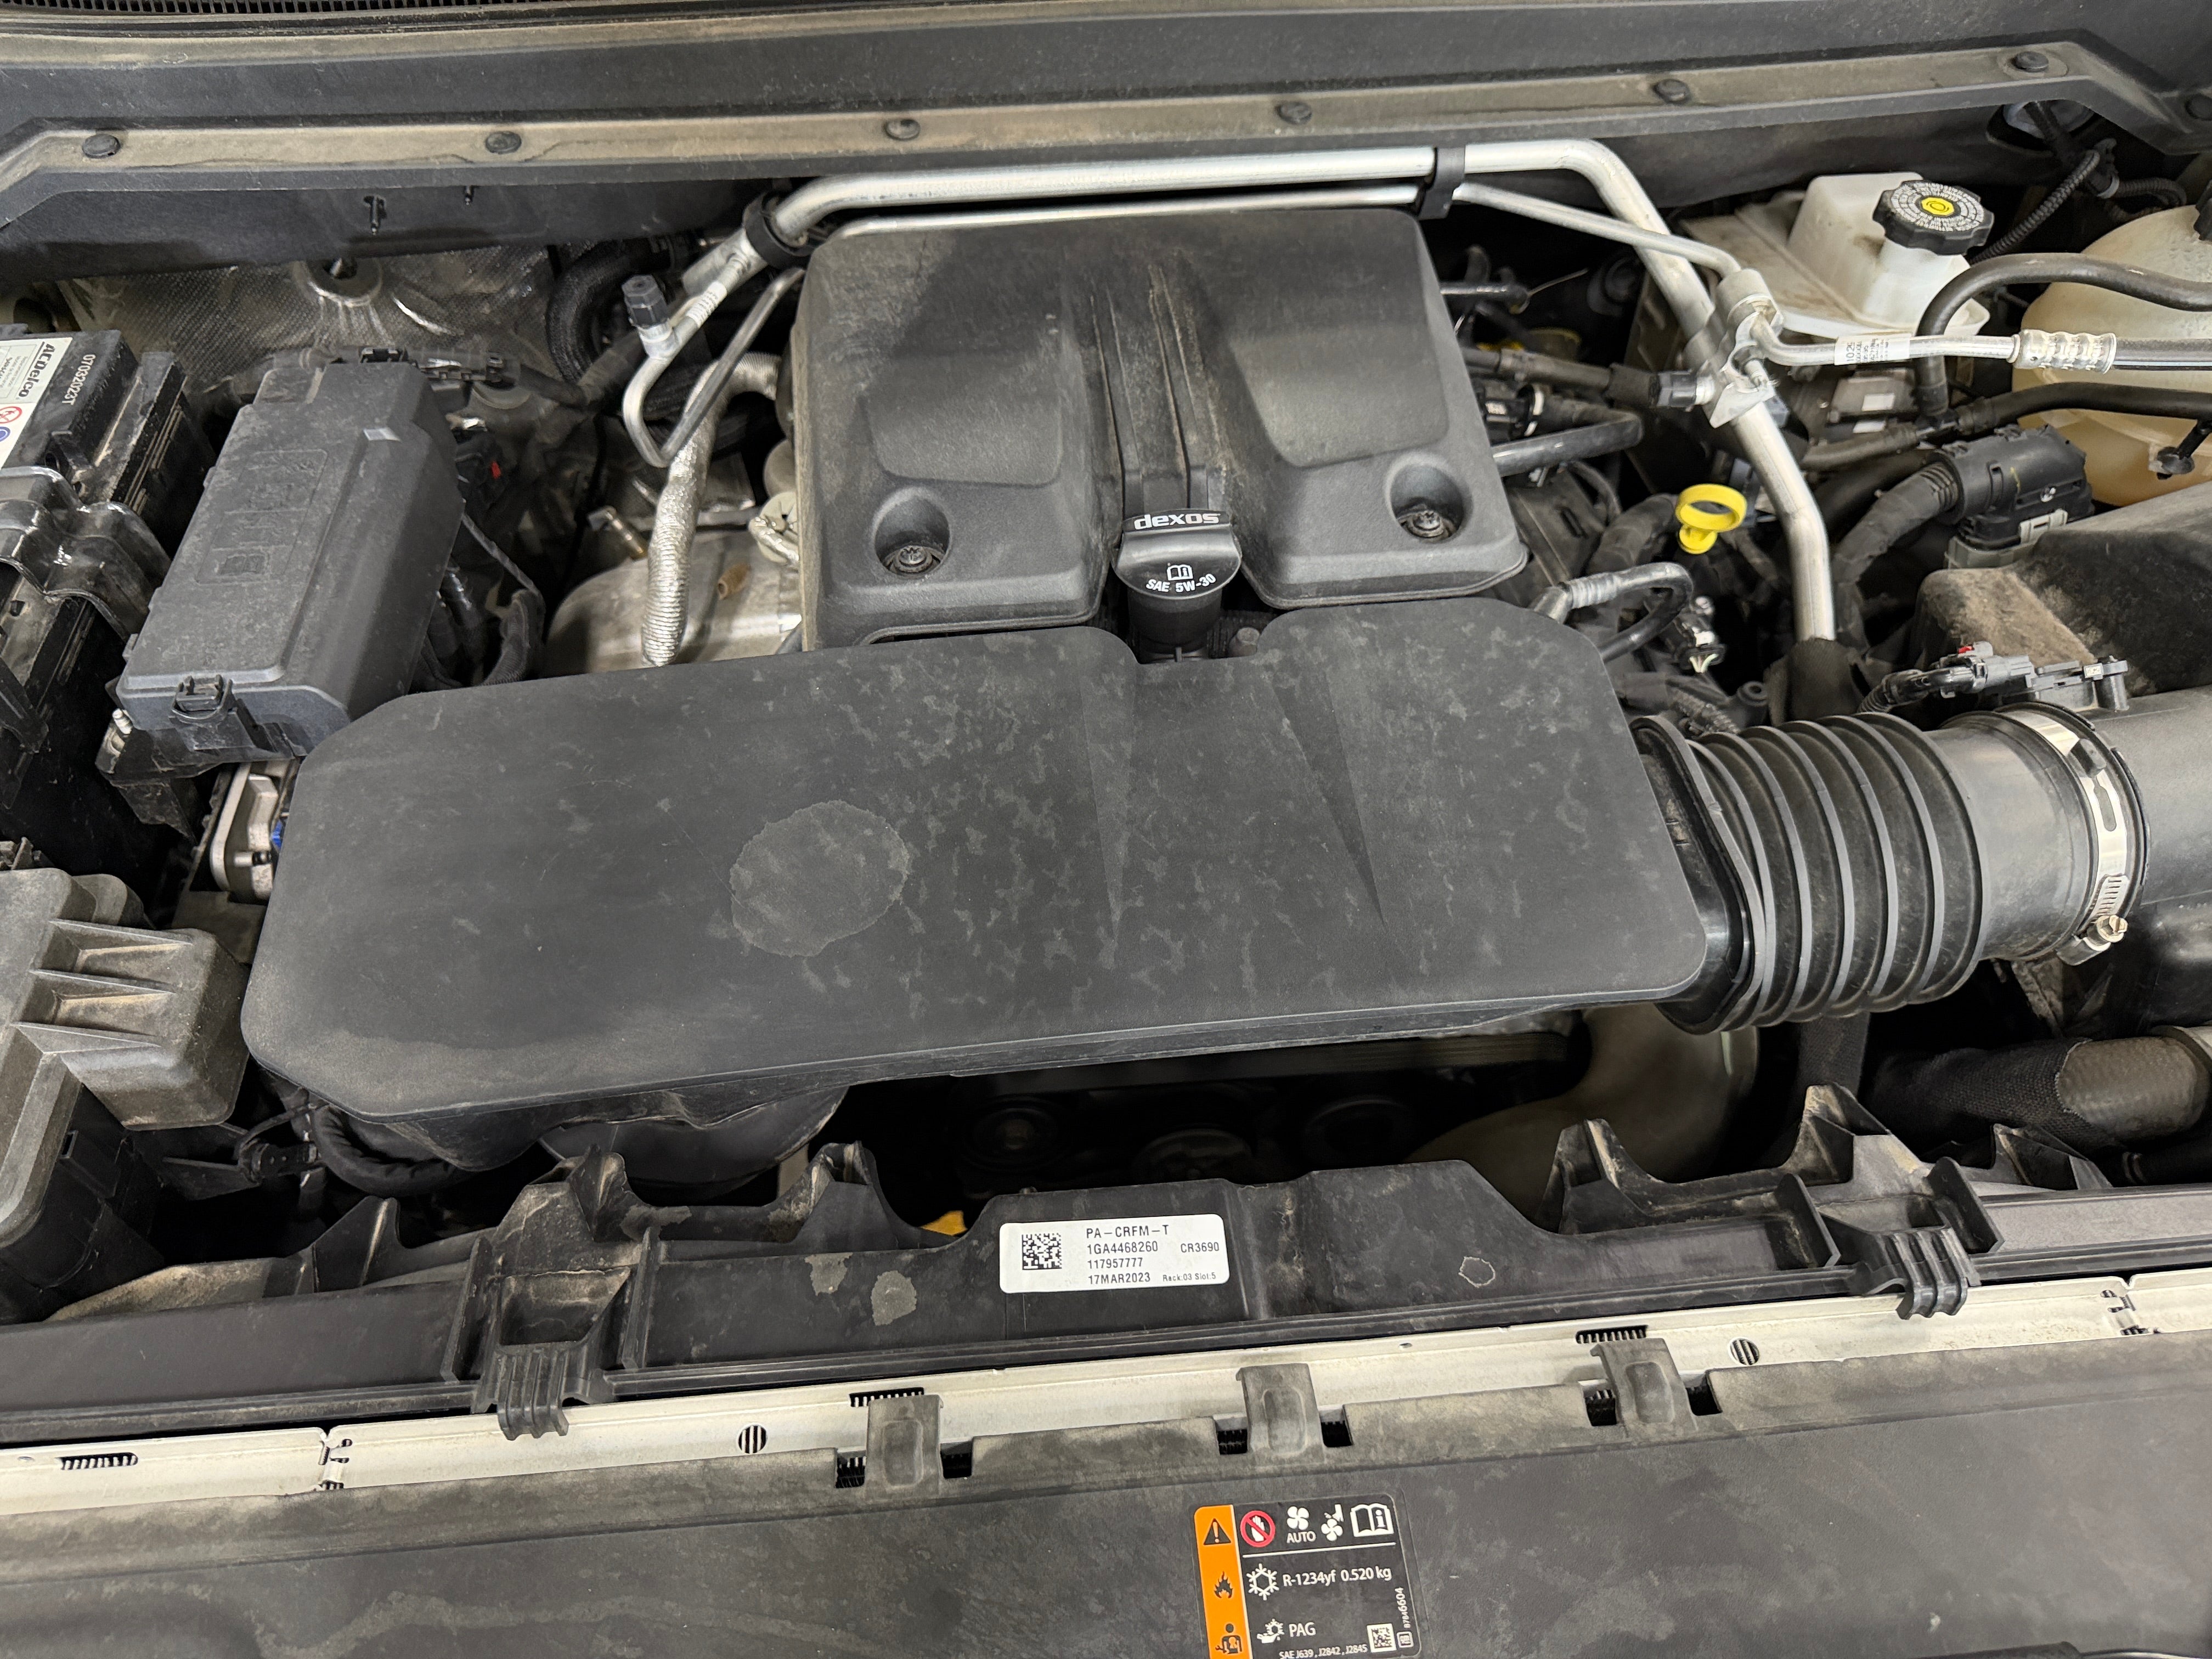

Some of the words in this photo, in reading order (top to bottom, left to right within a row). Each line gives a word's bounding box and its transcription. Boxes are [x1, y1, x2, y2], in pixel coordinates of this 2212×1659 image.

[19, 343, 55, 397] ACDelco
[62, 354, 96, 405] 07032023T
[1134, 513, 1221, 530] dexos
[1146, 579, 1170, 592] SAE
[1175, 573, 1216, 592] 5W-30
[1087, 1241, 1158, 1255] 1GA4468260
[1180, 1242, 1220, 1254] CR3690
[1087, 1257, 1143, 1269] 117957777
[1088, 1272, 1151, 1285] 17MAR2023
[1162, 1273, 1192, 1283] Rack:03
[1195, 1272, 1216, 1281] Slot:5
[1286, 1531, 1317, 1544] AUTO
[1282, 1569, 1336, 1587] R-1234yf
[1340, 1568, 1374, 1582] 0.520
[1375, 1566, 1392, 1582] kg
[1289, 1622, 1316, 1638] PAG
[1279, 1650, 1294, 1659] SAE
